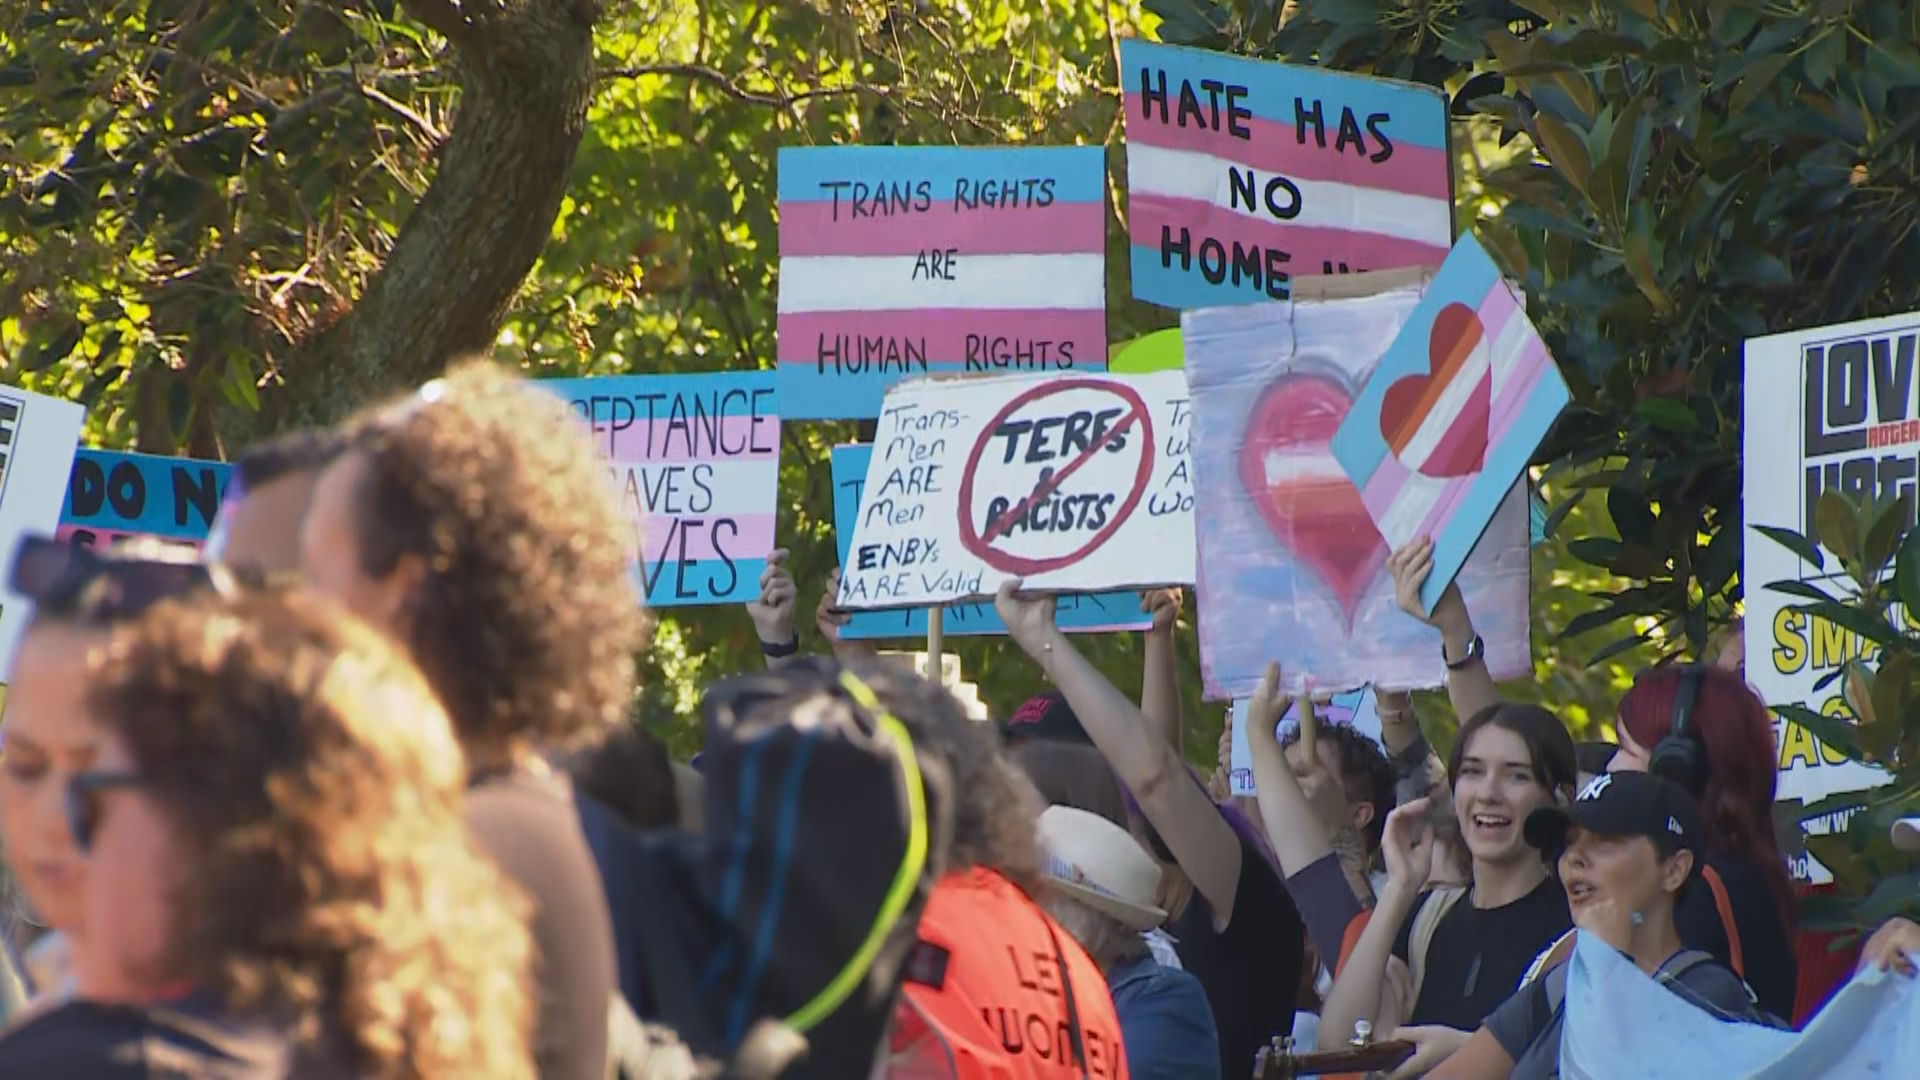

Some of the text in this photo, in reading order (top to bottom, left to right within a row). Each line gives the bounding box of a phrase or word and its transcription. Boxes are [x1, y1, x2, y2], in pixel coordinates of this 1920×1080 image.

[1141, 67, 1393, 164] HATE HAS
[820, 179, 1056, 222] TRANS RIGHTS
[1229, 166, 1302, 219] NO
[912, 248, 958, 280] ARE
[1161, 225, 1291, 301] HOME
[817, 333, 1075, 376] HUMAN RIGHTS
[1805, 334, 1920, 458] LOV
[570, 388, 775, 459] EPTANCE
[885, 435, 945, 464] Men
[70, 456, 226, 528] DO N
[877, 464, 944, 497] ARE
[865, 498, 924, 528] Men
[921, 569, 983, 595] Valid
[1006, 944, 1061, 997] LE
